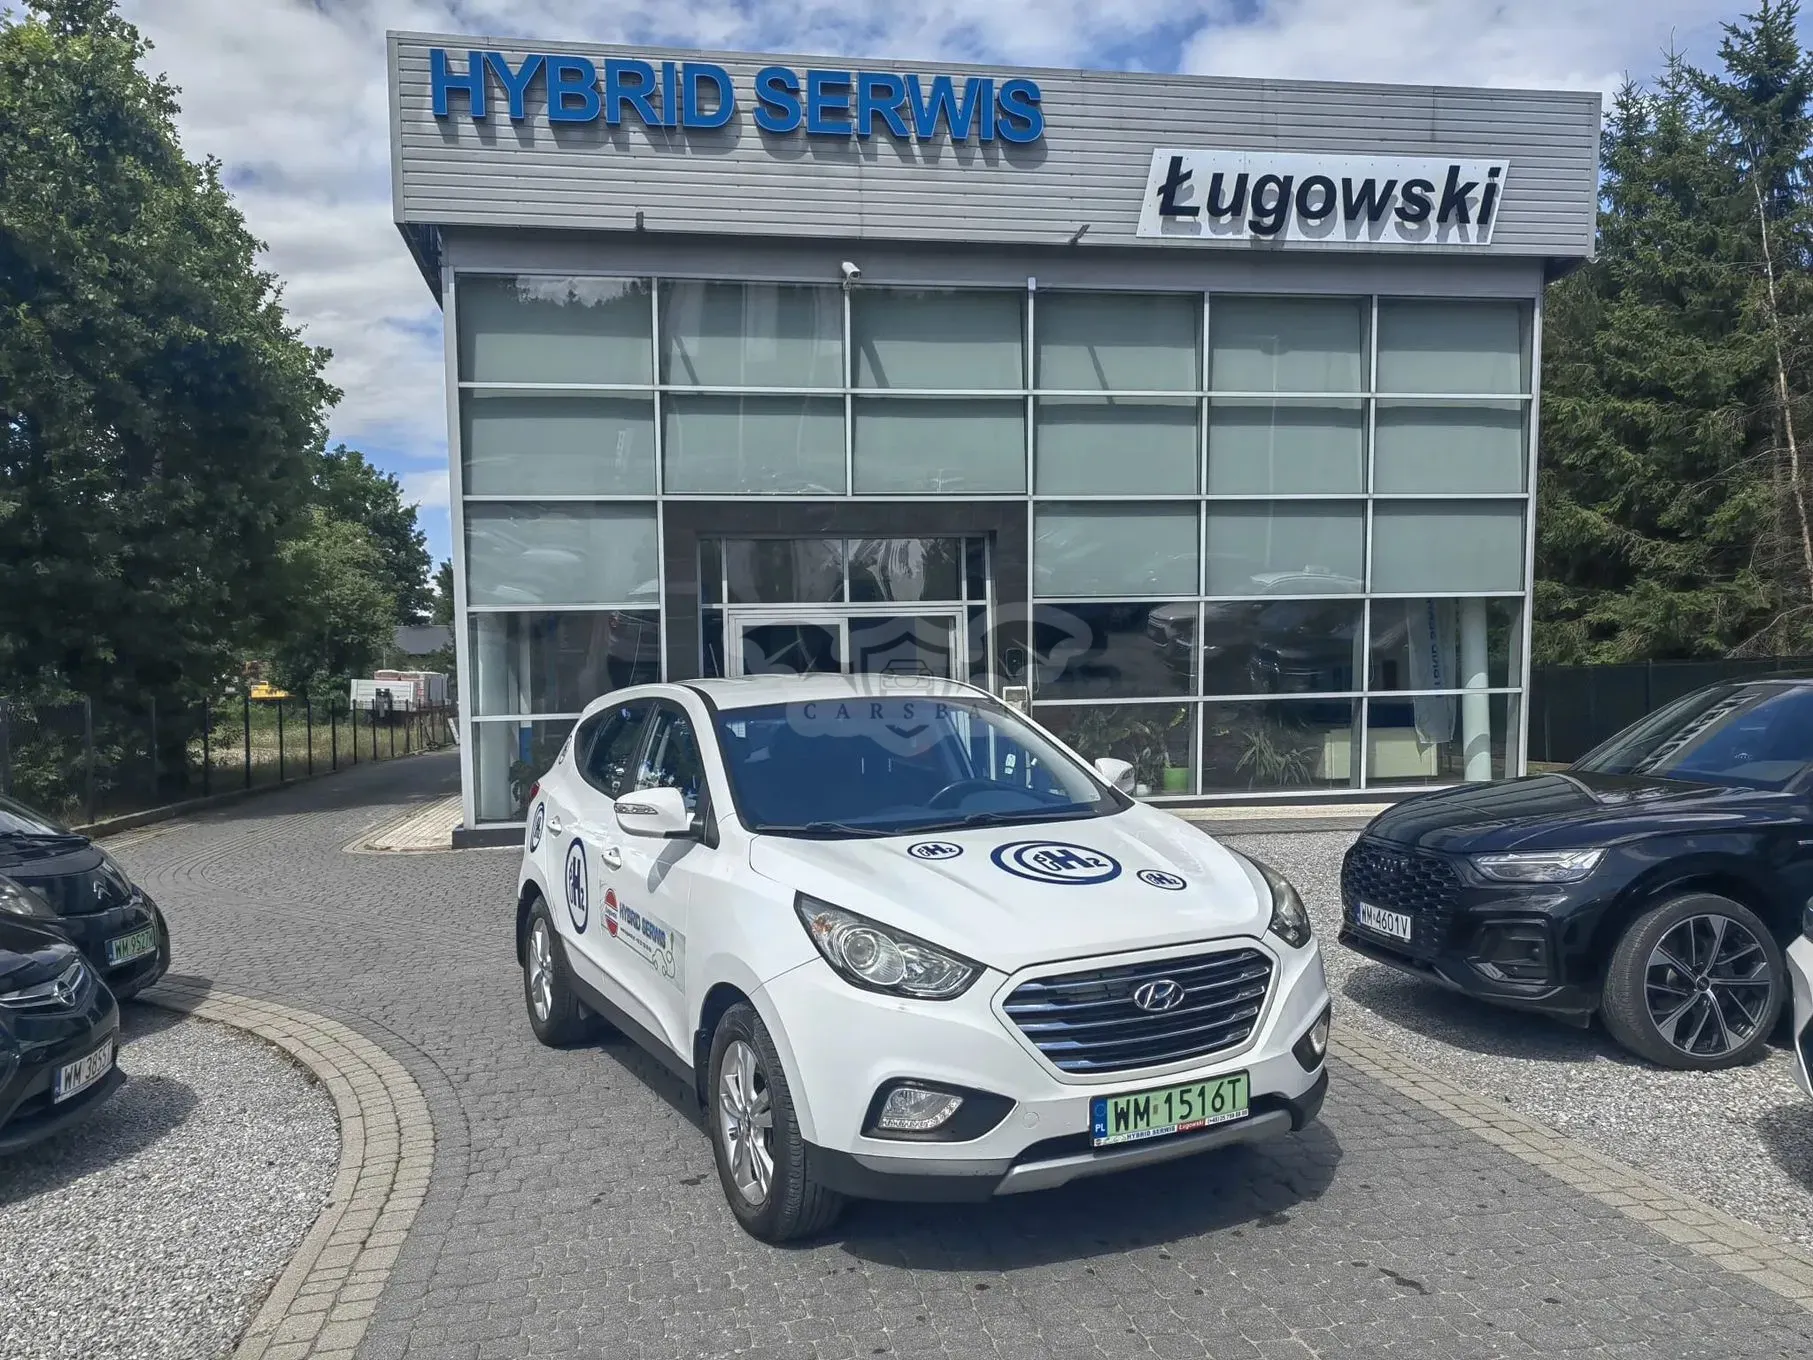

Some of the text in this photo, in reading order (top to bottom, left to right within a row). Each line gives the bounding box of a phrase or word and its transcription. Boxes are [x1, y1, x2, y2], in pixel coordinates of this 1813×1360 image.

[430, 48, 1045, 143] HYBRID SERWIS
[1157, 155, 1502, 235] Ługowski
[1374, 910, 1408, 936] 4601V
[65, 1062, 82, 1091] WM
[1114, 1078, 1241, 1132] WM 1516T
[1095, 1123, 1105, 1133] PL
[1127, 1126, 1175, 1140] HYBRID SERWIS
